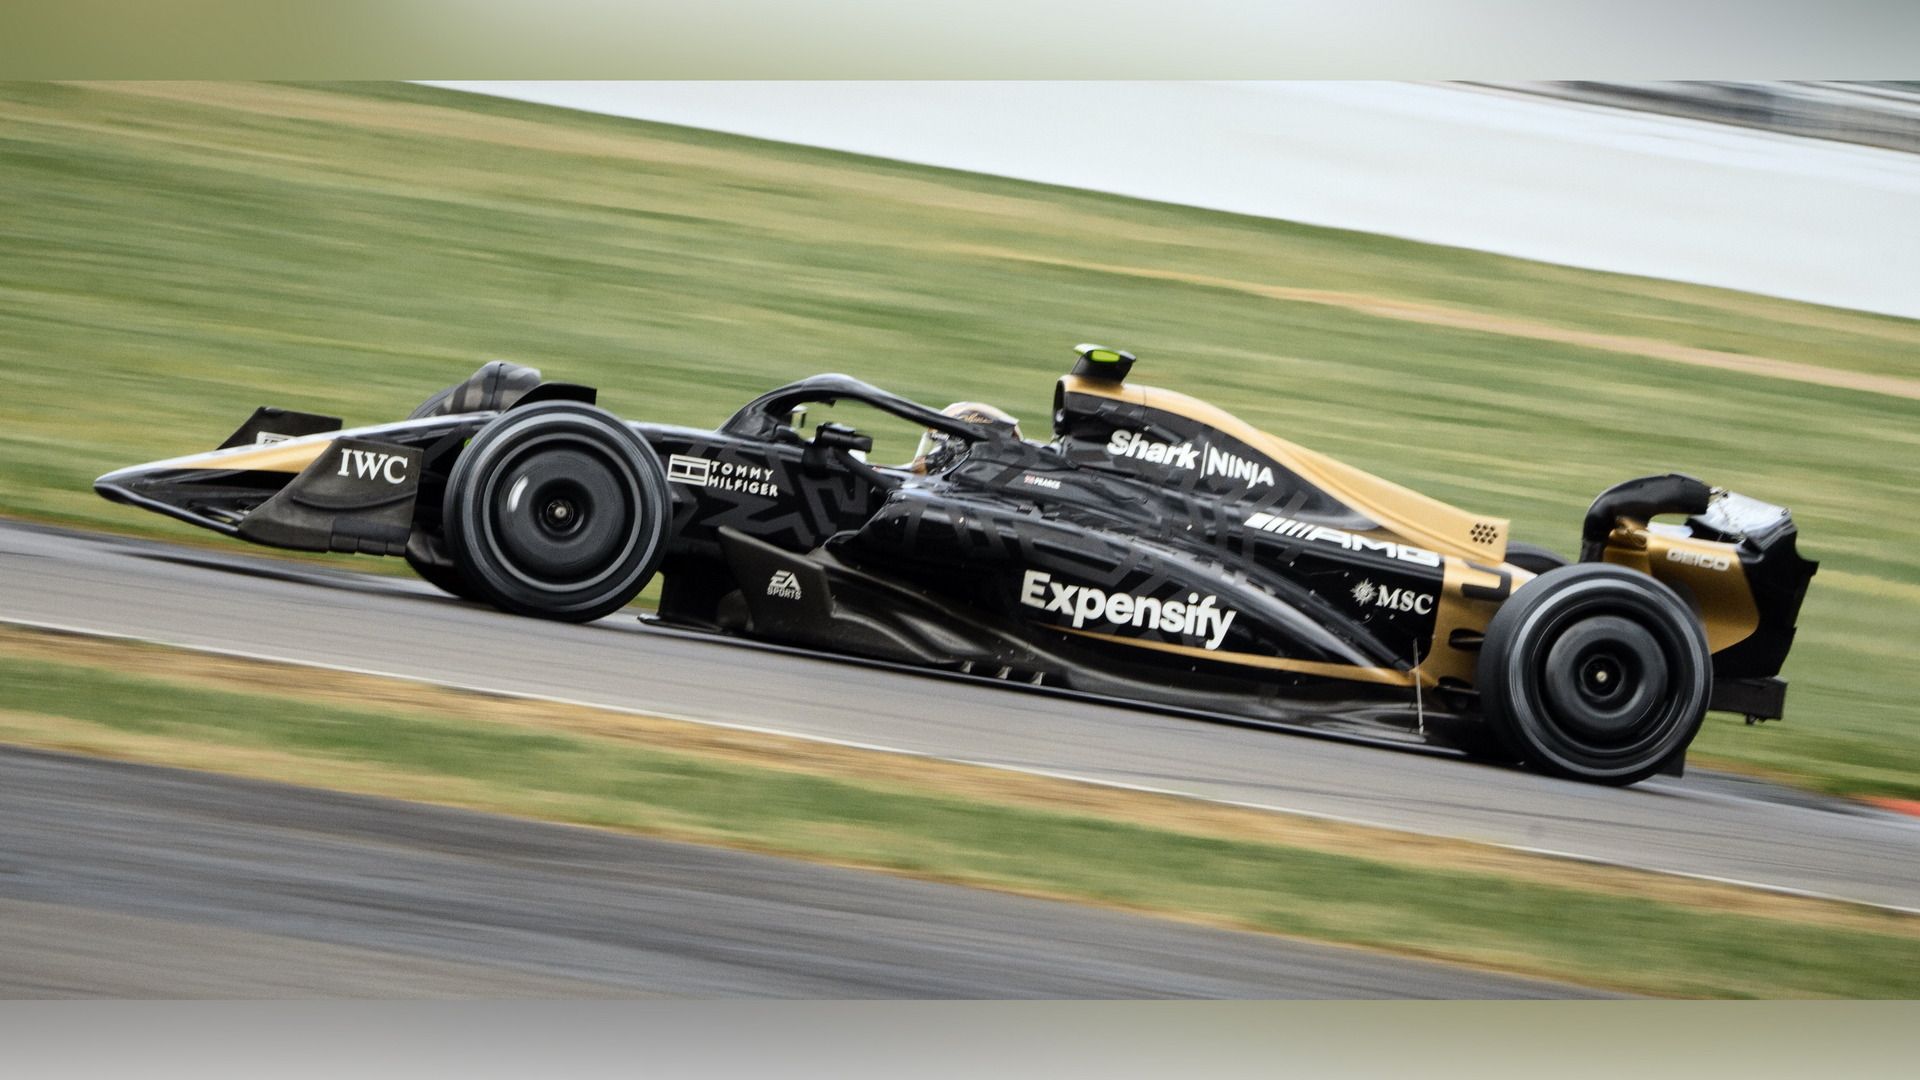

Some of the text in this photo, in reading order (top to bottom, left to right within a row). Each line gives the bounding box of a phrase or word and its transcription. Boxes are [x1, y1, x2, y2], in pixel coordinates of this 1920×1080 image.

[337, 449, 408, 485] IWC
[1106, 429, 1275, 489] Shark NINJA
[711, 460, 774, 482] TOMMY
[707, 475, 779, 498] HILFIGER
[1666, 548, 1731, 571] GEICO
[768, 569, 801, 590] EA
[766, 586, 802, 600] SPORTS
[1375, 584, 1434, 615] MSC
[1020, 568, 1237, 651] Expensify
